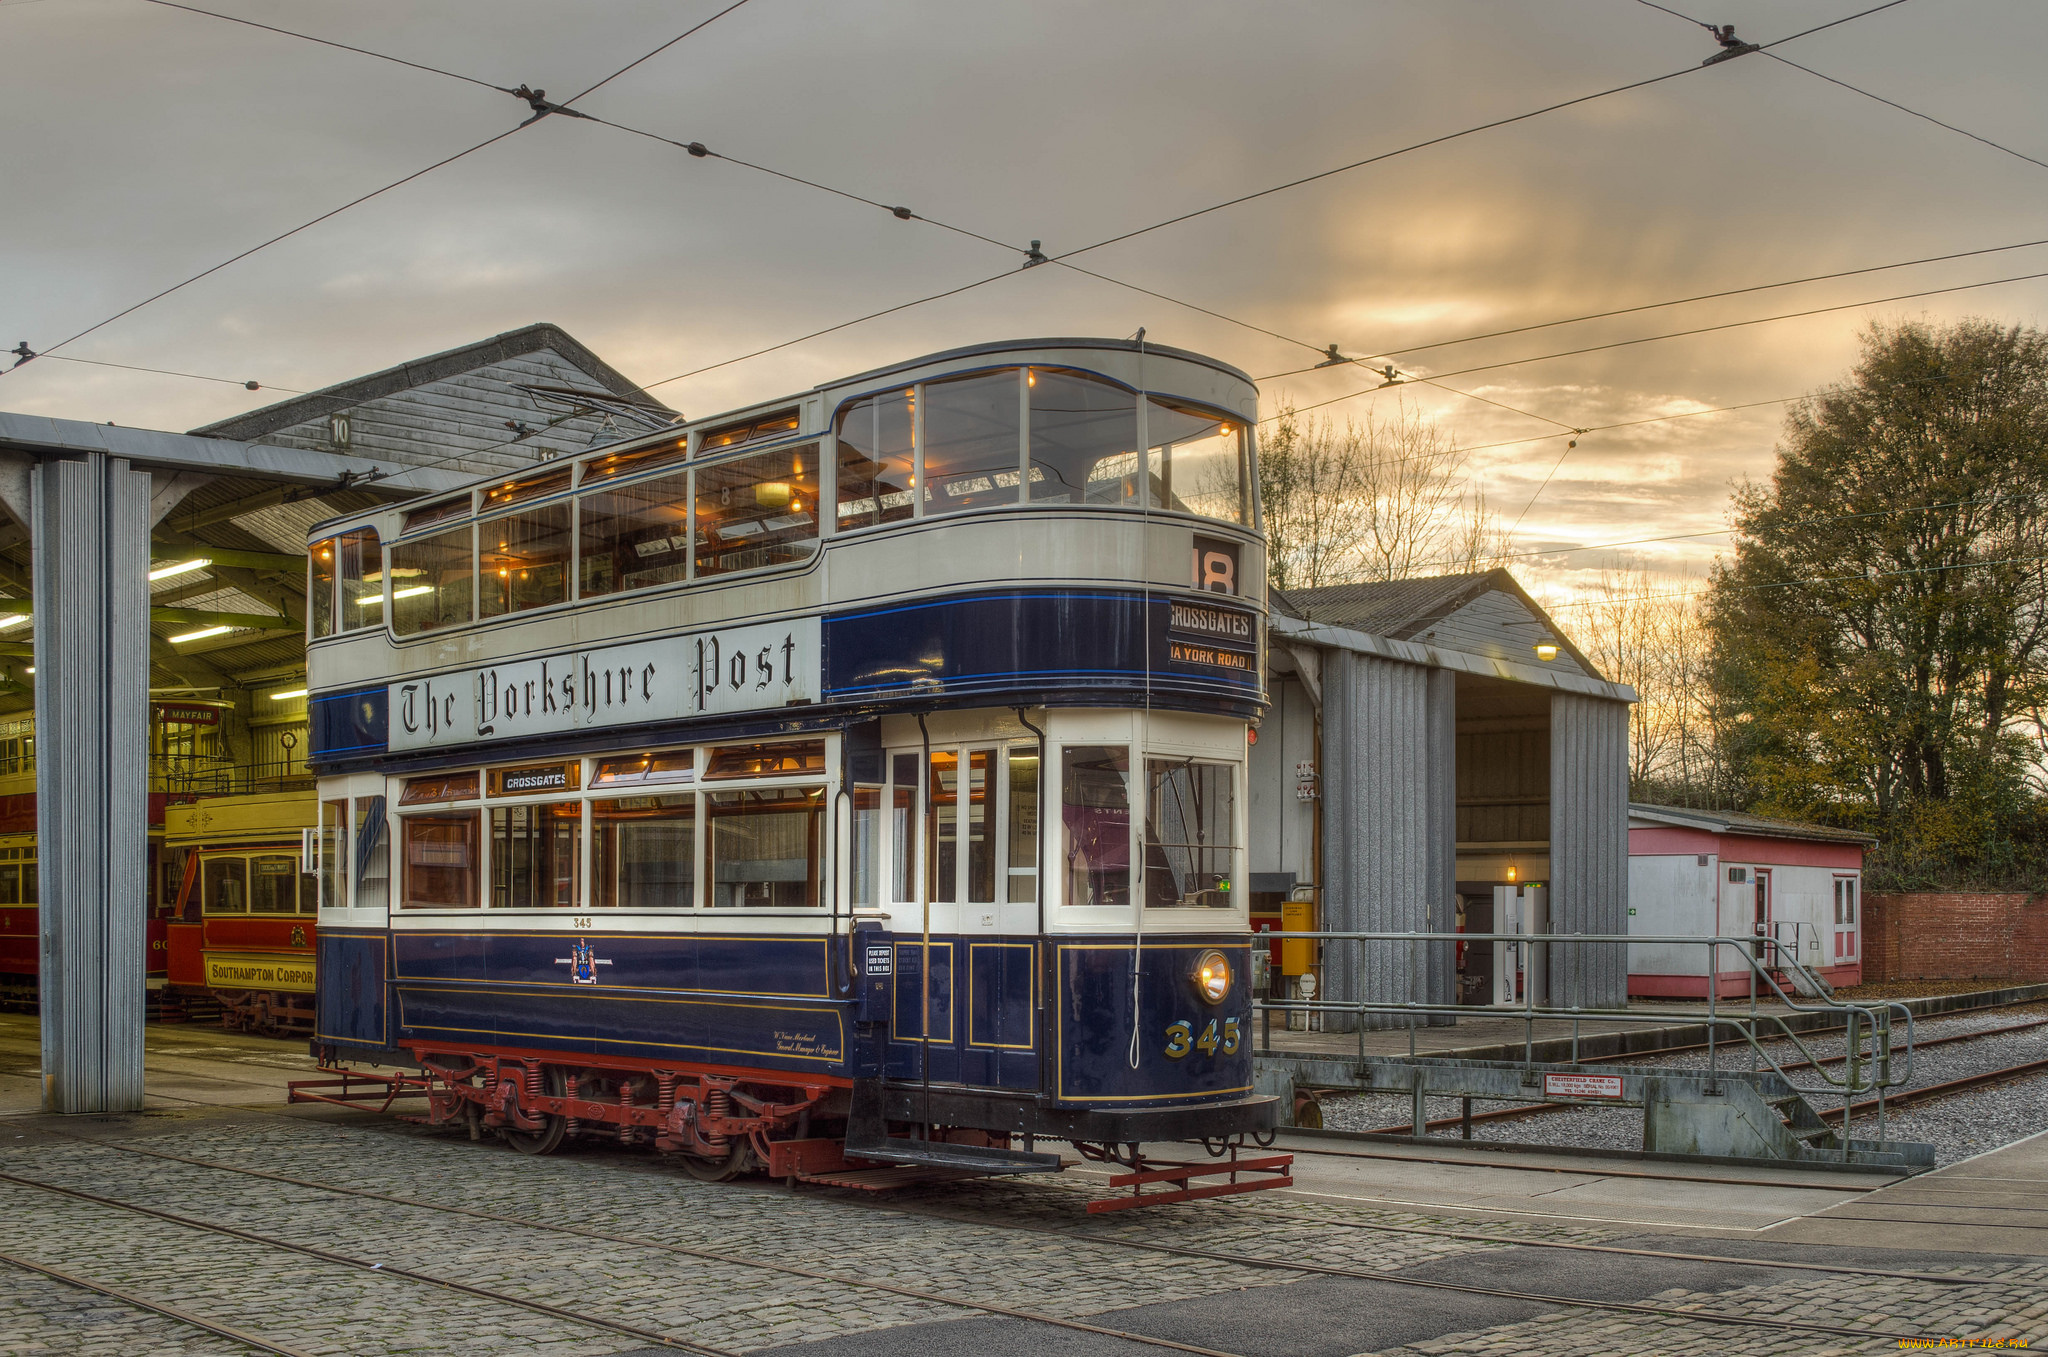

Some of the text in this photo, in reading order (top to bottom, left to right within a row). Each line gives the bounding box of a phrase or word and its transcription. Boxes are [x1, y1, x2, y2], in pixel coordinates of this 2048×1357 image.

[331, 418, 348, 443] 10
[1192, 548, 1233, 595] 18
[1184, 648, 1214, 664] YORK
[1217, 653, 1246, 668] ROAD
[401, 632, 796, 744] The Yorkshire Post
[172, 711, 212, 720] MAYFAIR
[507, 773, 565, 789] CROSSGATES
[573, 917, 592, 928] 345
[212, 964, 274, 982] SOUTHAMPTON
[1164, 1017, 1240, 1059] 345
